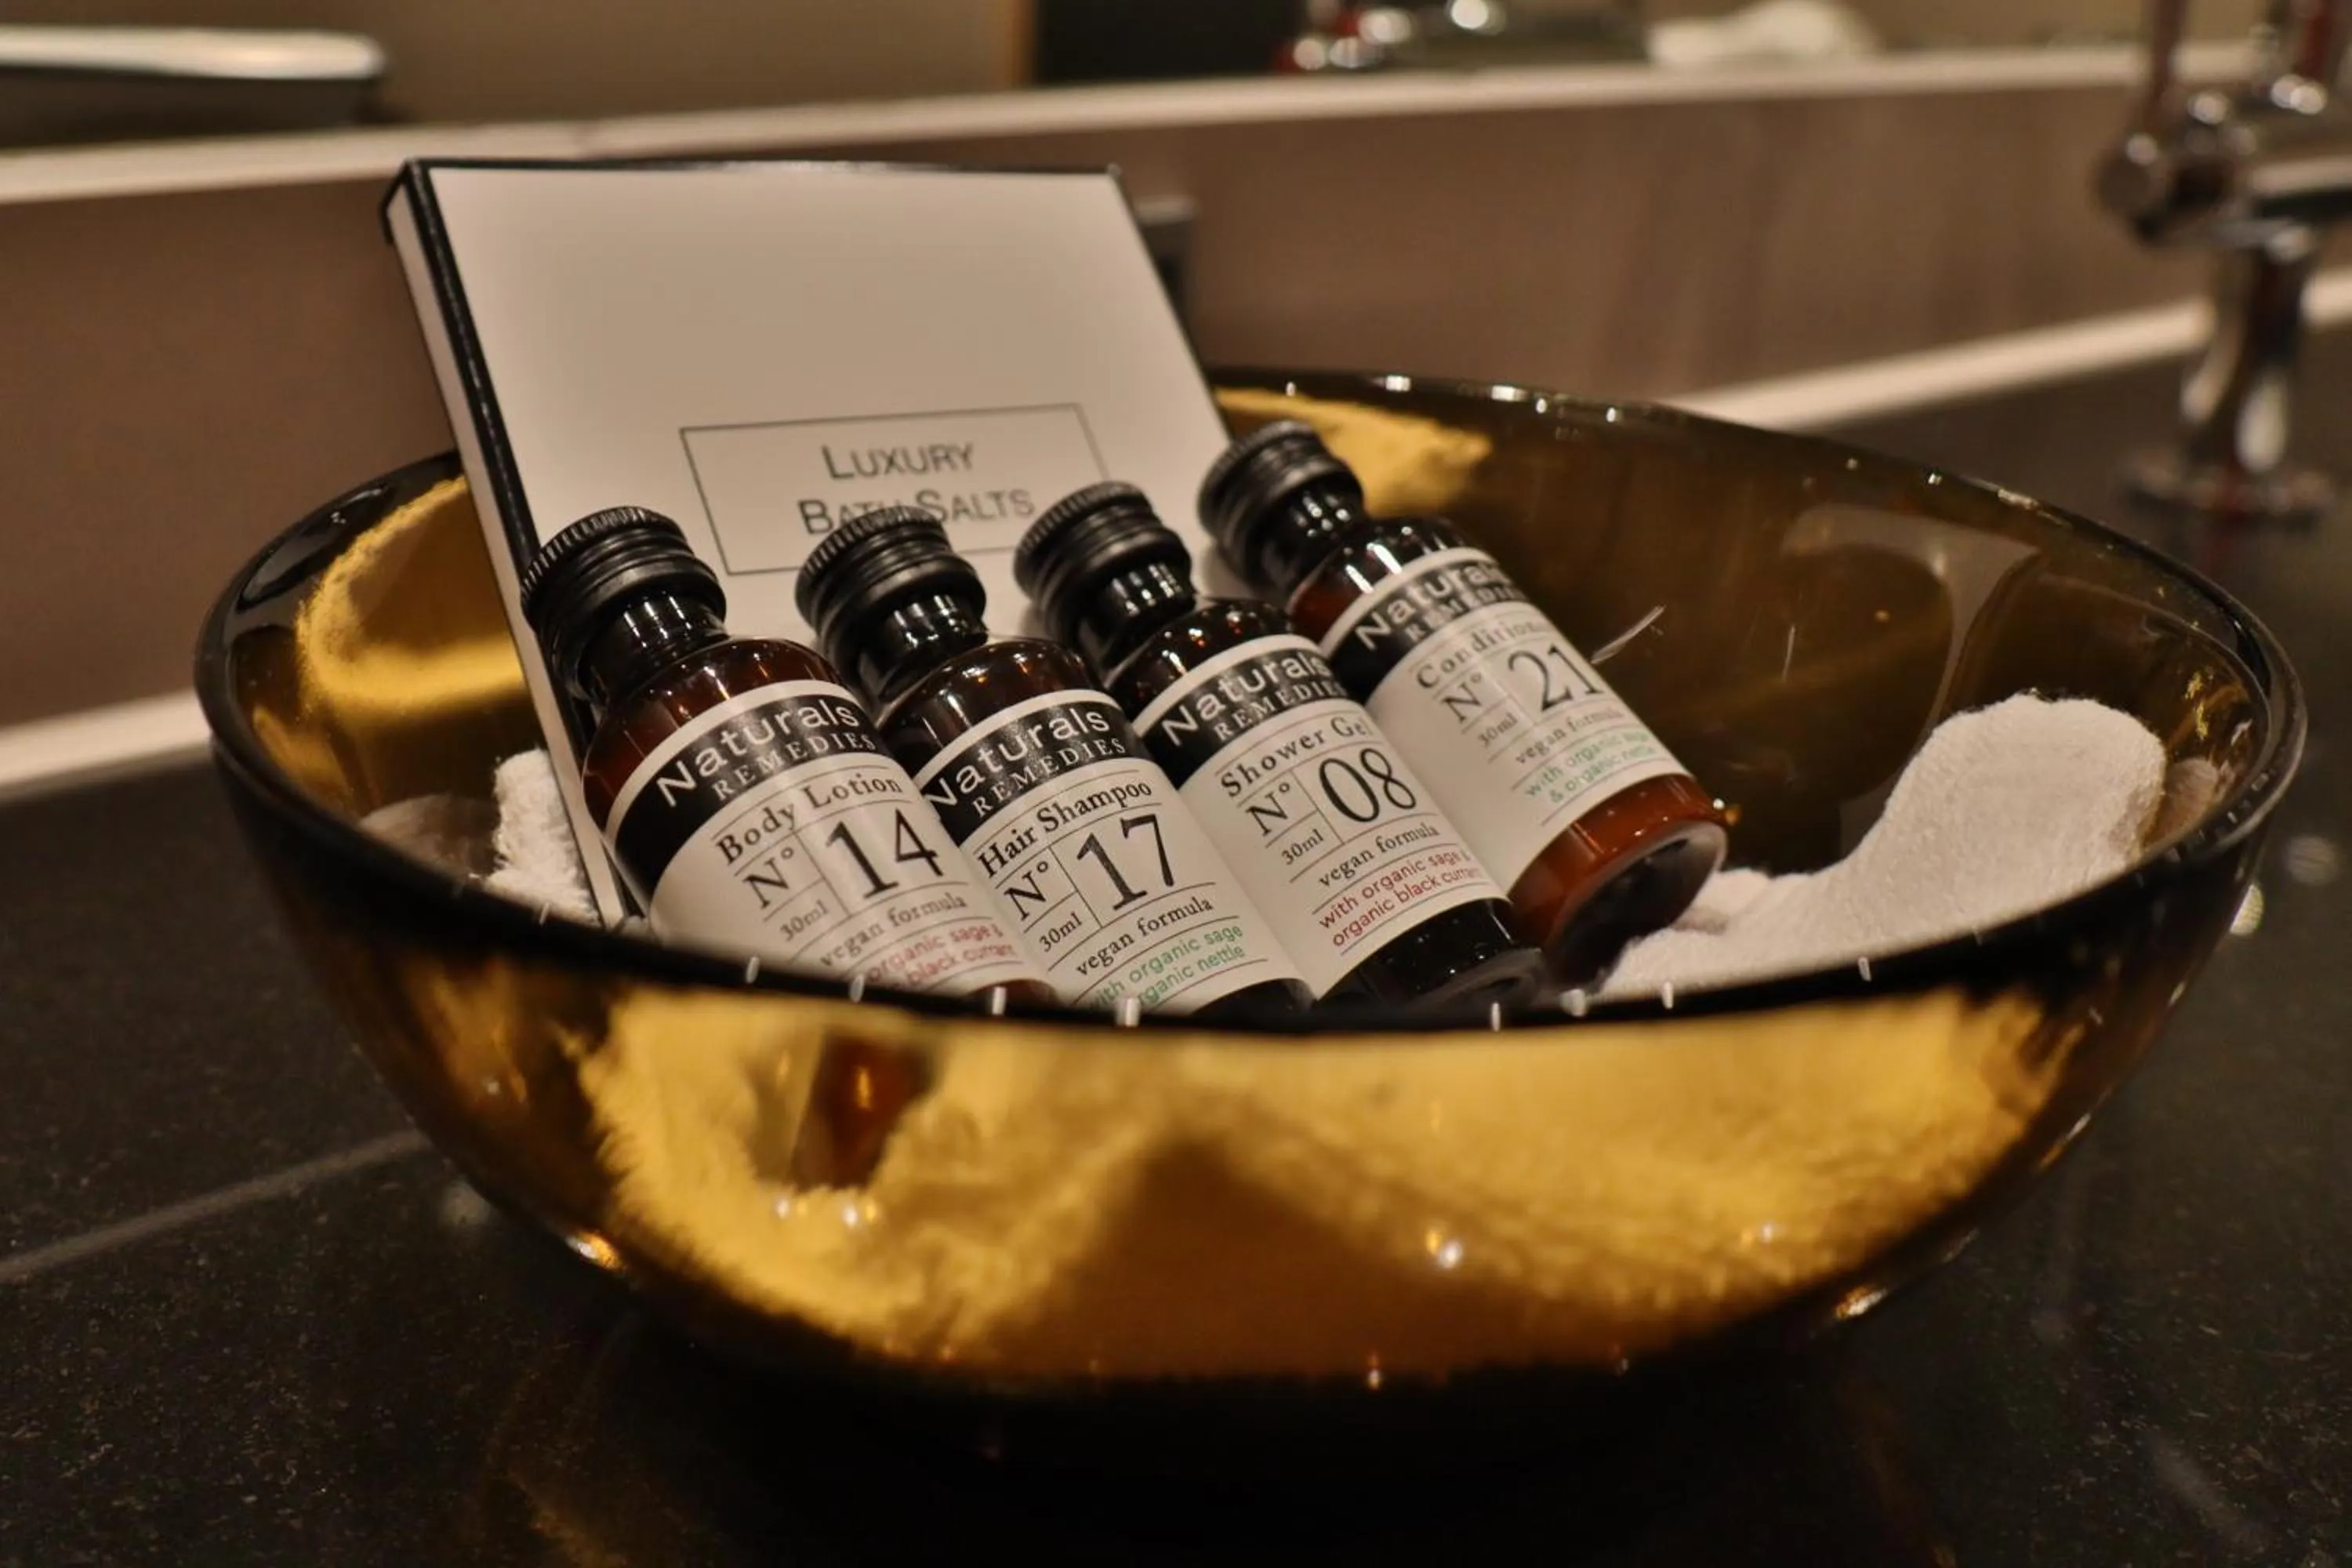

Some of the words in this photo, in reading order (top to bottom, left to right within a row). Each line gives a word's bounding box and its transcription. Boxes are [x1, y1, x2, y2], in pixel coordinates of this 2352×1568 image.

[822, 442, 975, 480] LUXURY
[797, 499, 900, 535] BAT
[1161, 652, 1332, 746] Naturals
[1214, 680, 1348, 741] REMEDIE
[1508, 643, 1605, 712] 21
[656, 699, 859, 808] Naturals
[713, 732, 877, 801] REMEDIES
[925, 708, 1110, 806] Naturals
[973, 738, 1126, 817] REMEDIES
[1221, 727, 1326, 798] Shower
[1515, 726, 1566, 764] vegan
[1525, 765, 1563, 797] with
[717, 798, 797, 864] Body
[803, 771, 902, 808] Lotion
[1319, 748, 1417, 824] 08
[825, 807, 944, 898] 14
[978, 826, 1035, 878] Hair
[1036, 781, 1153, 831] Shampoo
[1076, 813, 1174, 910] 17
[1281, 829, 1325, 866] 30ml
[1319, 850, 1375, 887] vegan
[1375, 822, 1441, 854] formula
[779, 898, 828, 941] 30ml
[1319, 895, 1359, 930] with
[1362, 859, 1427, 900] organic
[1428, 850, 1461, 867] sage
[1333, 898, 1396, 947] organic
[1393, 873, 1442, 904] black
[820, 922, 884, 967] vegan
[887, 892, 968, 928] formula
[867, 935, 946, 982] organic
[1039, 911, 1083, 953] 30ml
[1076, 934, 1135, 976] vegan
[1137, 896, 1214, 936] formula
[1092, 980, 1125, 1009] ith
[1129, 939, 1201, 982] organic
[1203, 924, 1243, 946] sage
[1138, 966, 1194, 1007] rganic
[1197, 943, 1245, 971] nettle
